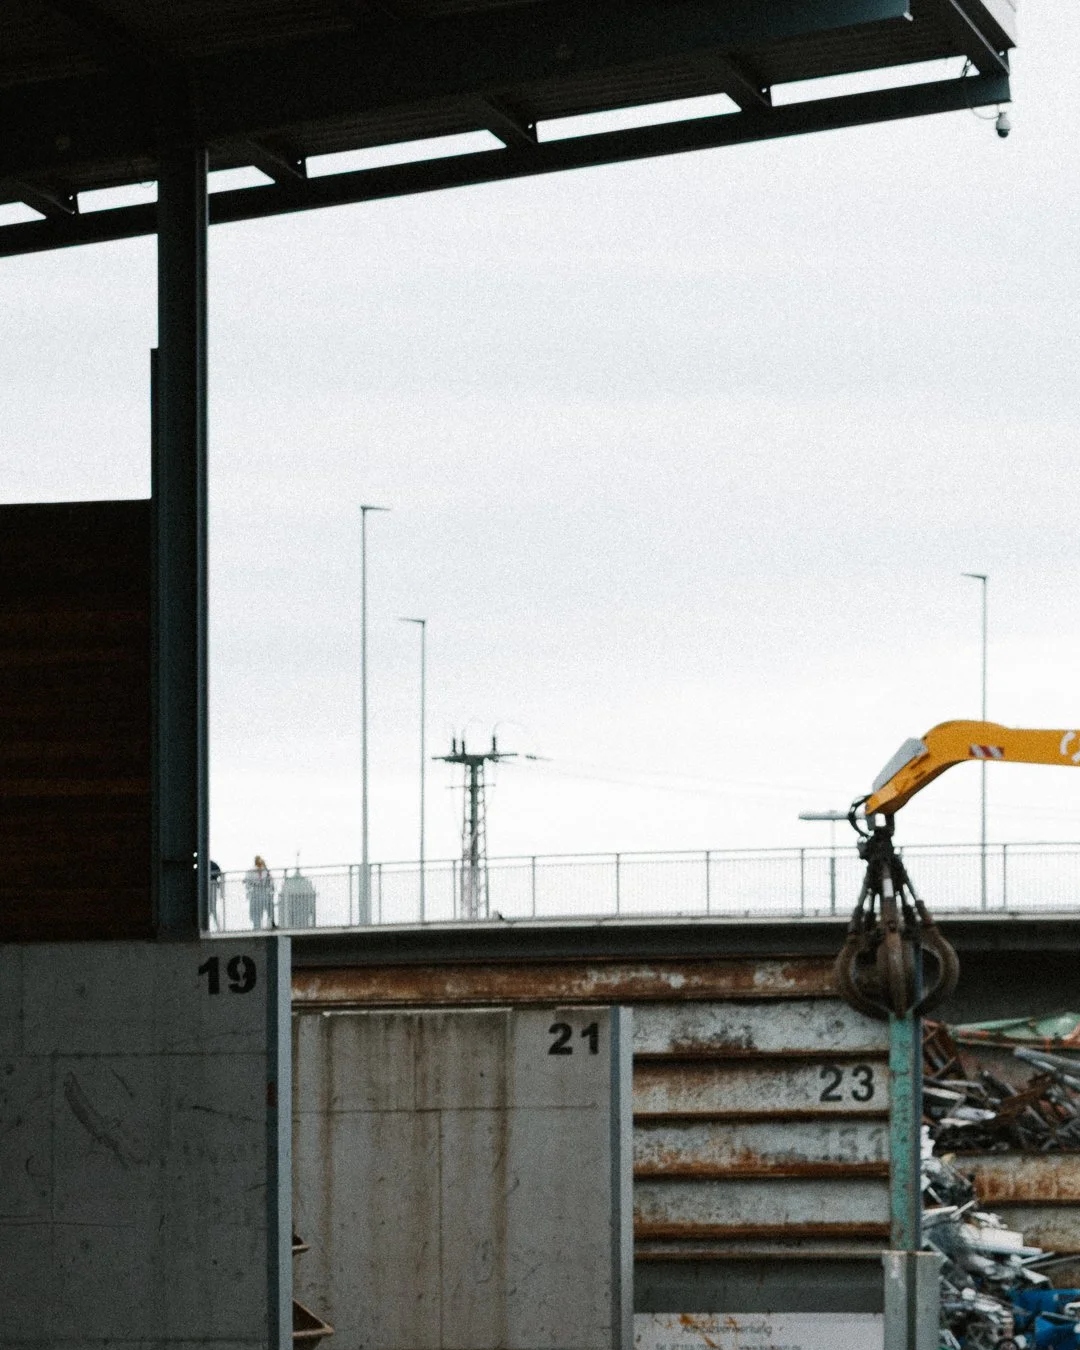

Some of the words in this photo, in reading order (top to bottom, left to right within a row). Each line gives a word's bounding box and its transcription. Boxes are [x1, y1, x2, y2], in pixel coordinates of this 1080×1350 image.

[198, 956, 257, 994] 19
[548, 1022, 599, 1055] 21
[820, 1064, 875, 1102] 23
